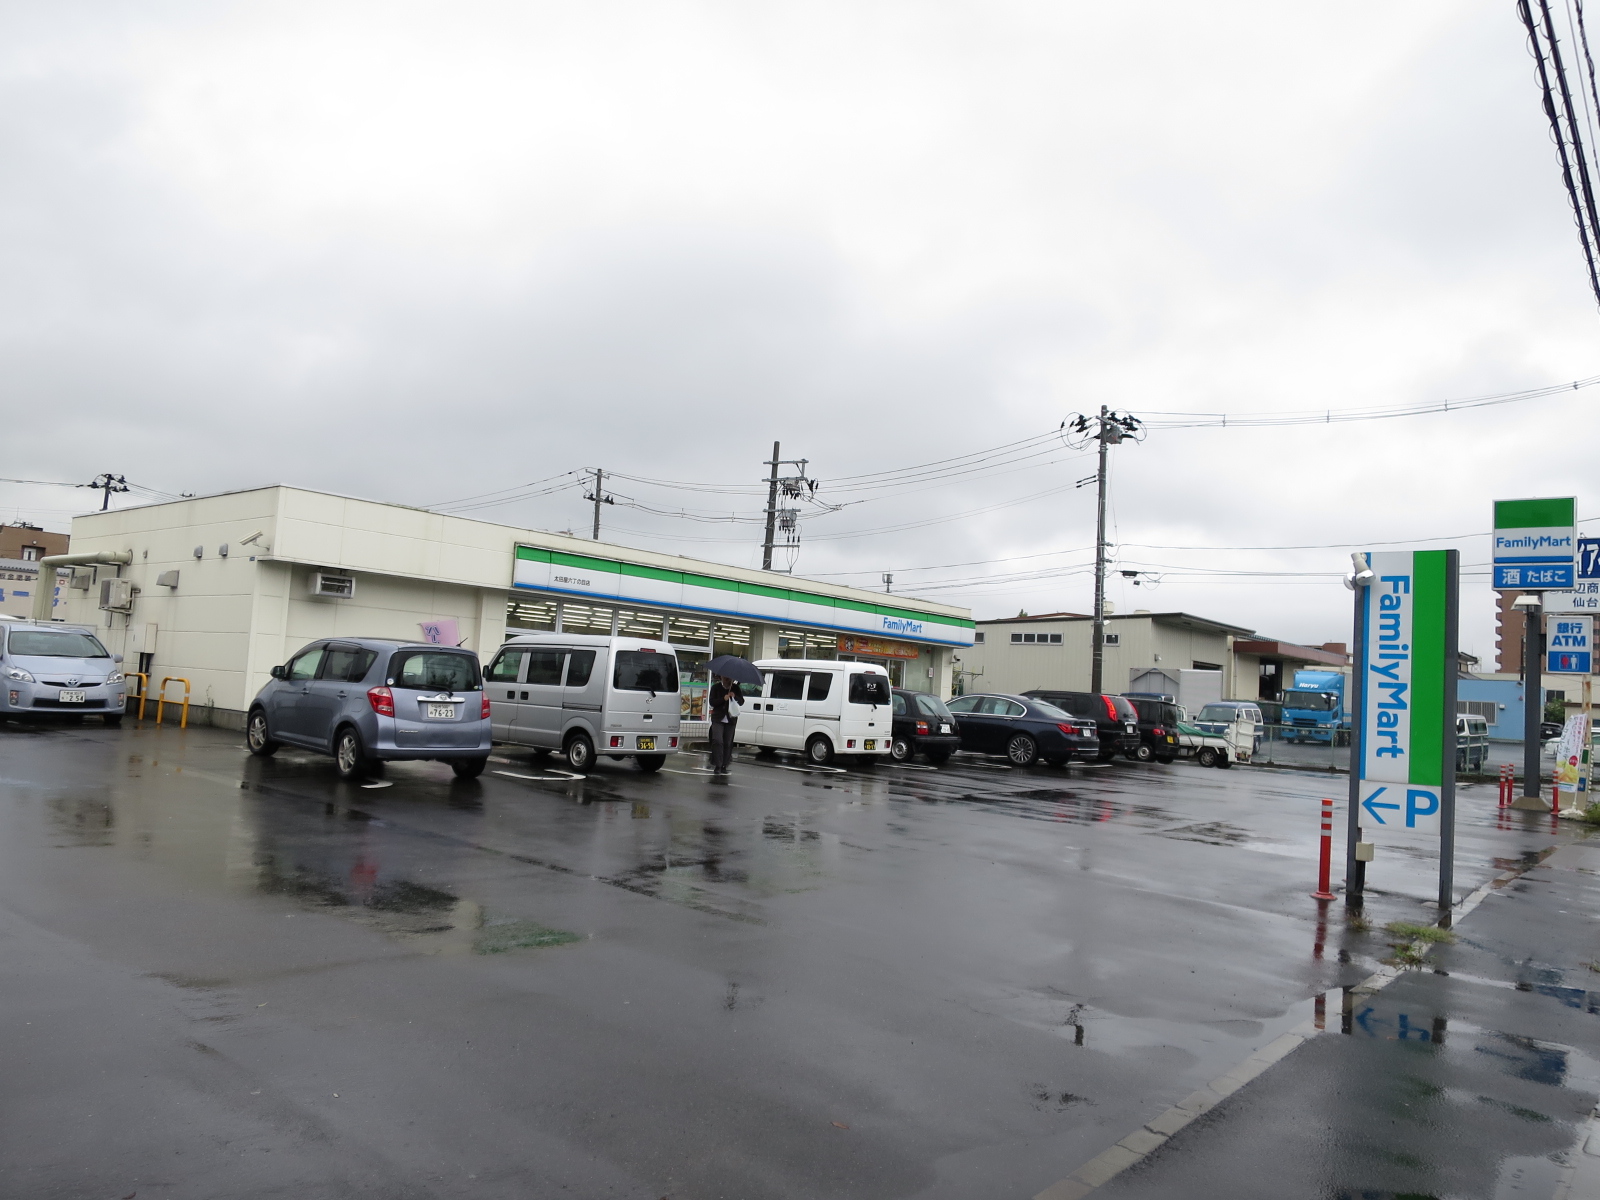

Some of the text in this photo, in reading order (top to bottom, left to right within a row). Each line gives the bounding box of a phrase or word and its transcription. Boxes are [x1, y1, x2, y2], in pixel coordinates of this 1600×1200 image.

[1496, 536, 1571, 550] FamilyMart
[1576, 543, 1600, 576] イア
[1502, 569, 1566, 585] 酒 たばこ
[883, 617, 923, 634] FamilyMart
[1557, 622, 1583, 634] 銀行
[1551, 635, 1586, 647] ATM
[1369, 575, 1410, 759] FamilyMart
[1405, 789, 1439, 828] P
